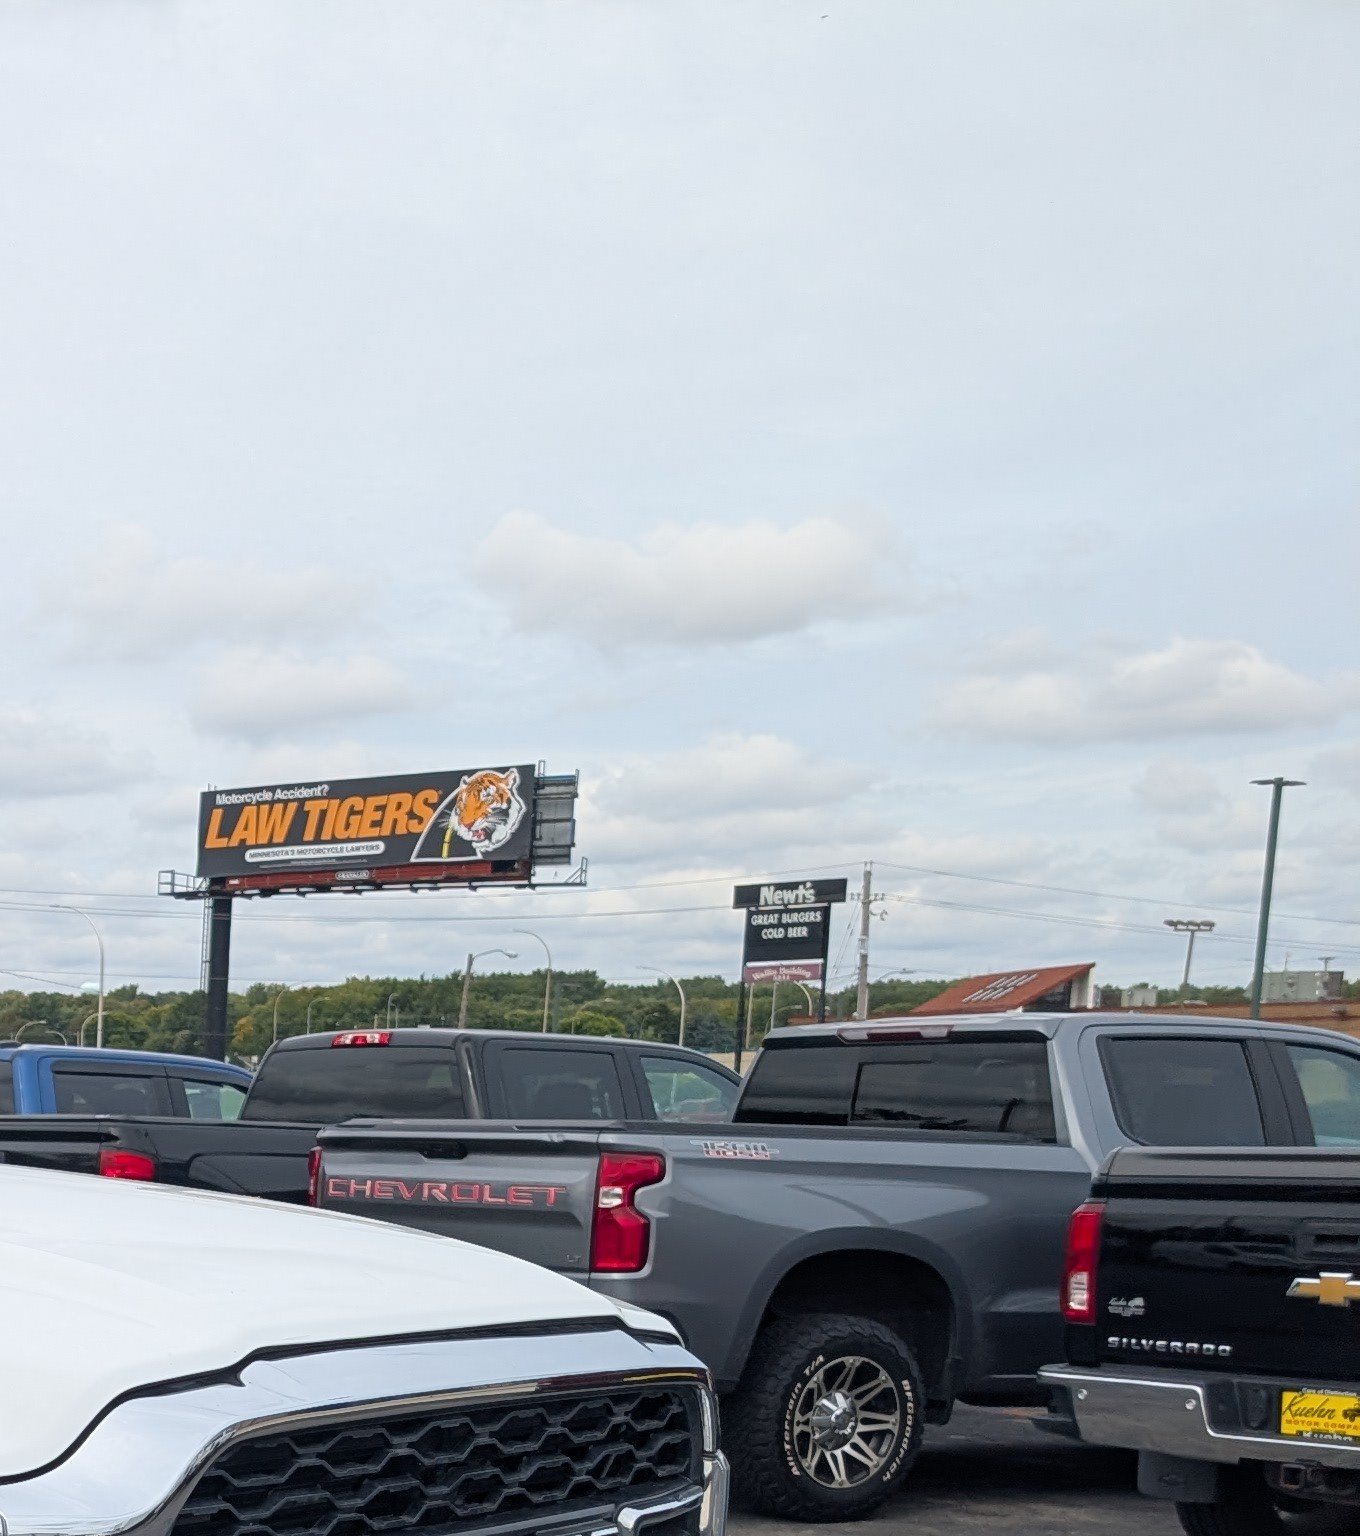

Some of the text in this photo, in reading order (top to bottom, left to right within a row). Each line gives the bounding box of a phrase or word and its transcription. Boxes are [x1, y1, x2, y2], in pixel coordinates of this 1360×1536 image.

[215, 784, 330, 806] Motorcycle Accident?
[204, 788, 440, 849] LAW TIGERS
[759, 881, 816, 906] Newt's
[751, 910, 822, 925] GREAT BURGERS
[761, 926, 808, 940] COLD BEER
[327, 1178, 568, 1207] CHEVROLET
[1107, 1336, 1233, 1357] SILVERADO
[1282, 1393, 1336, 1420] Kuehn
[1285, 1418, 1360, 1431] MOTOR COMPA
